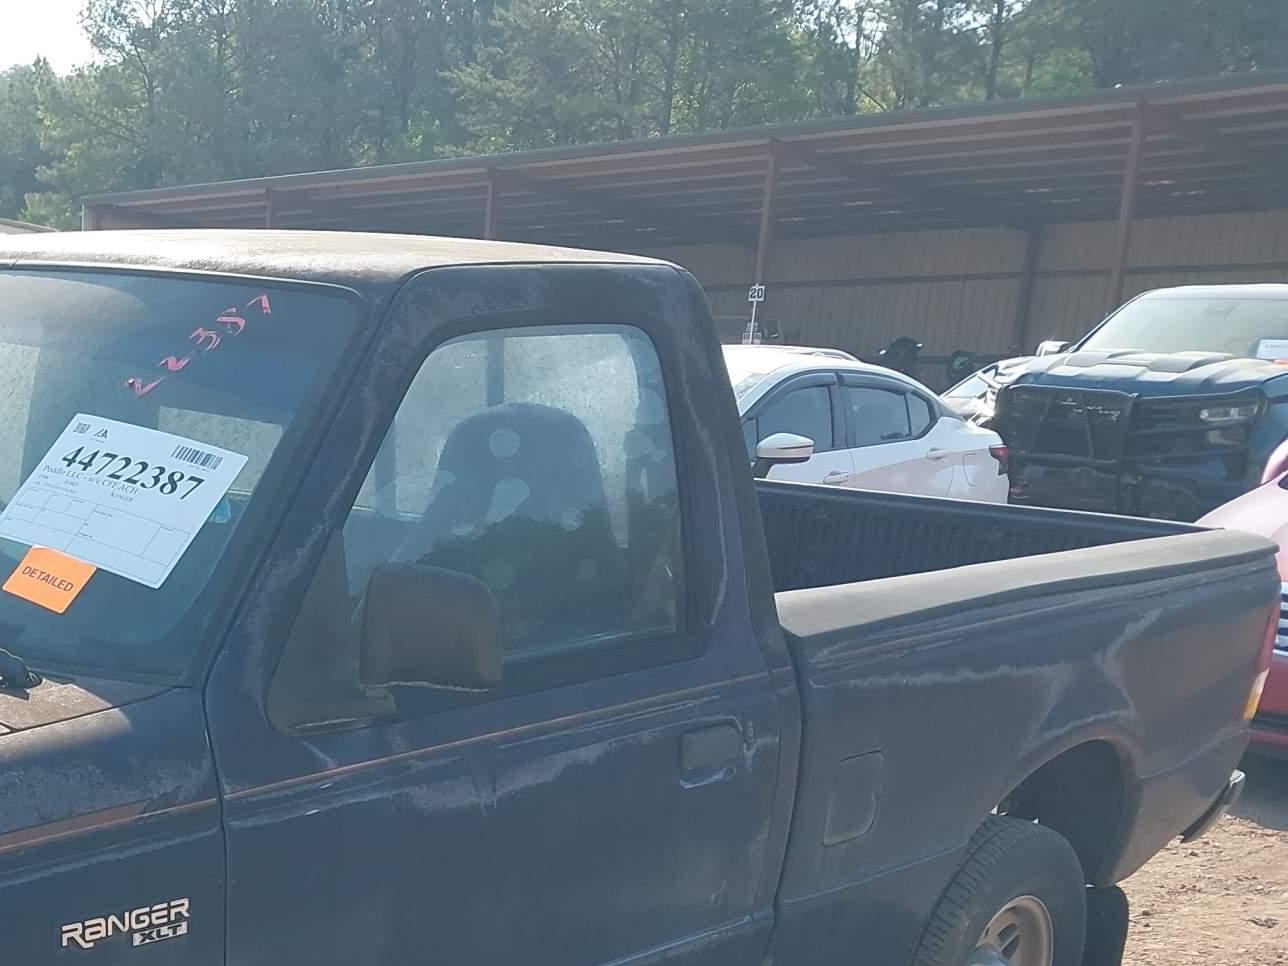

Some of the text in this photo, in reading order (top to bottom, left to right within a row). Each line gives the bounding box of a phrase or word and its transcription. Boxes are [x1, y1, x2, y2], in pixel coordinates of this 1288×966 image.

[749, 287, 764, 299] 20
[61, 446, 206, 500] 44722387
[22, 565, 74, 592] DETAILED
[138, 923, 184, 944] XLT
